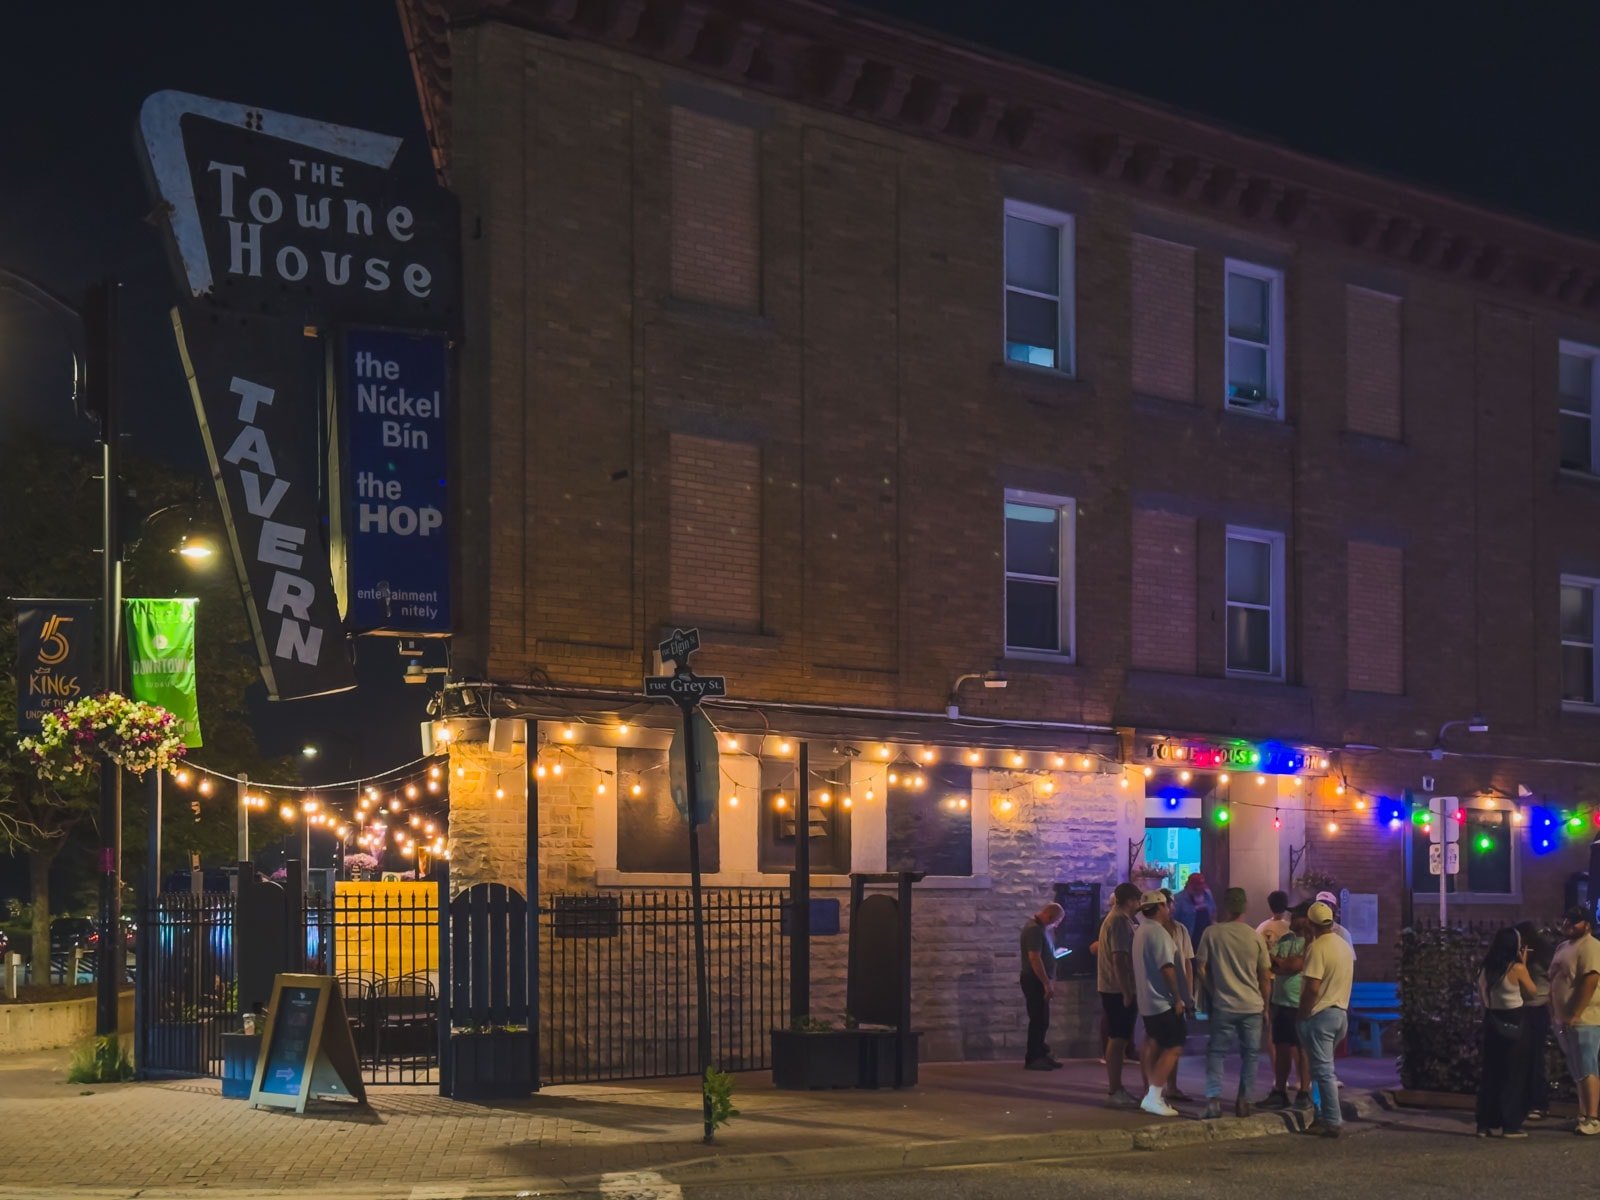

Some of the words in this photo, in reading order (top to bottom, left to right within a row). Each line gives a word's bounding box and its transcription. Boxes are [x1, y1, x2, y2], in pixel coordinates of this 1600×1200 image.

[289, 159, 344, 187] THE
[207, 160, 415, 242] Towne
[228, 220, 432, 298] House
[355, 352, 400, 380] the
[357, 384, 440, 418] Nickel
[382, 421, 428, 450] Bin
[357, 472, 402, 500] the
[223, 376, 323, 666] TAVERN
[359, 504, 443, 536] HOP
[357, 588, 438, 602] enteainment
[401, 604, 438, 619] nitely
[671, 639, 690, 656] Elgin
[29, 673, 81, 696] KINGS
[649, 682, 667, 690] rue
[670, 679, 706, 695] Grey
[708, 680, 722, 689] St.
[41, 699, 51, 708] OF
